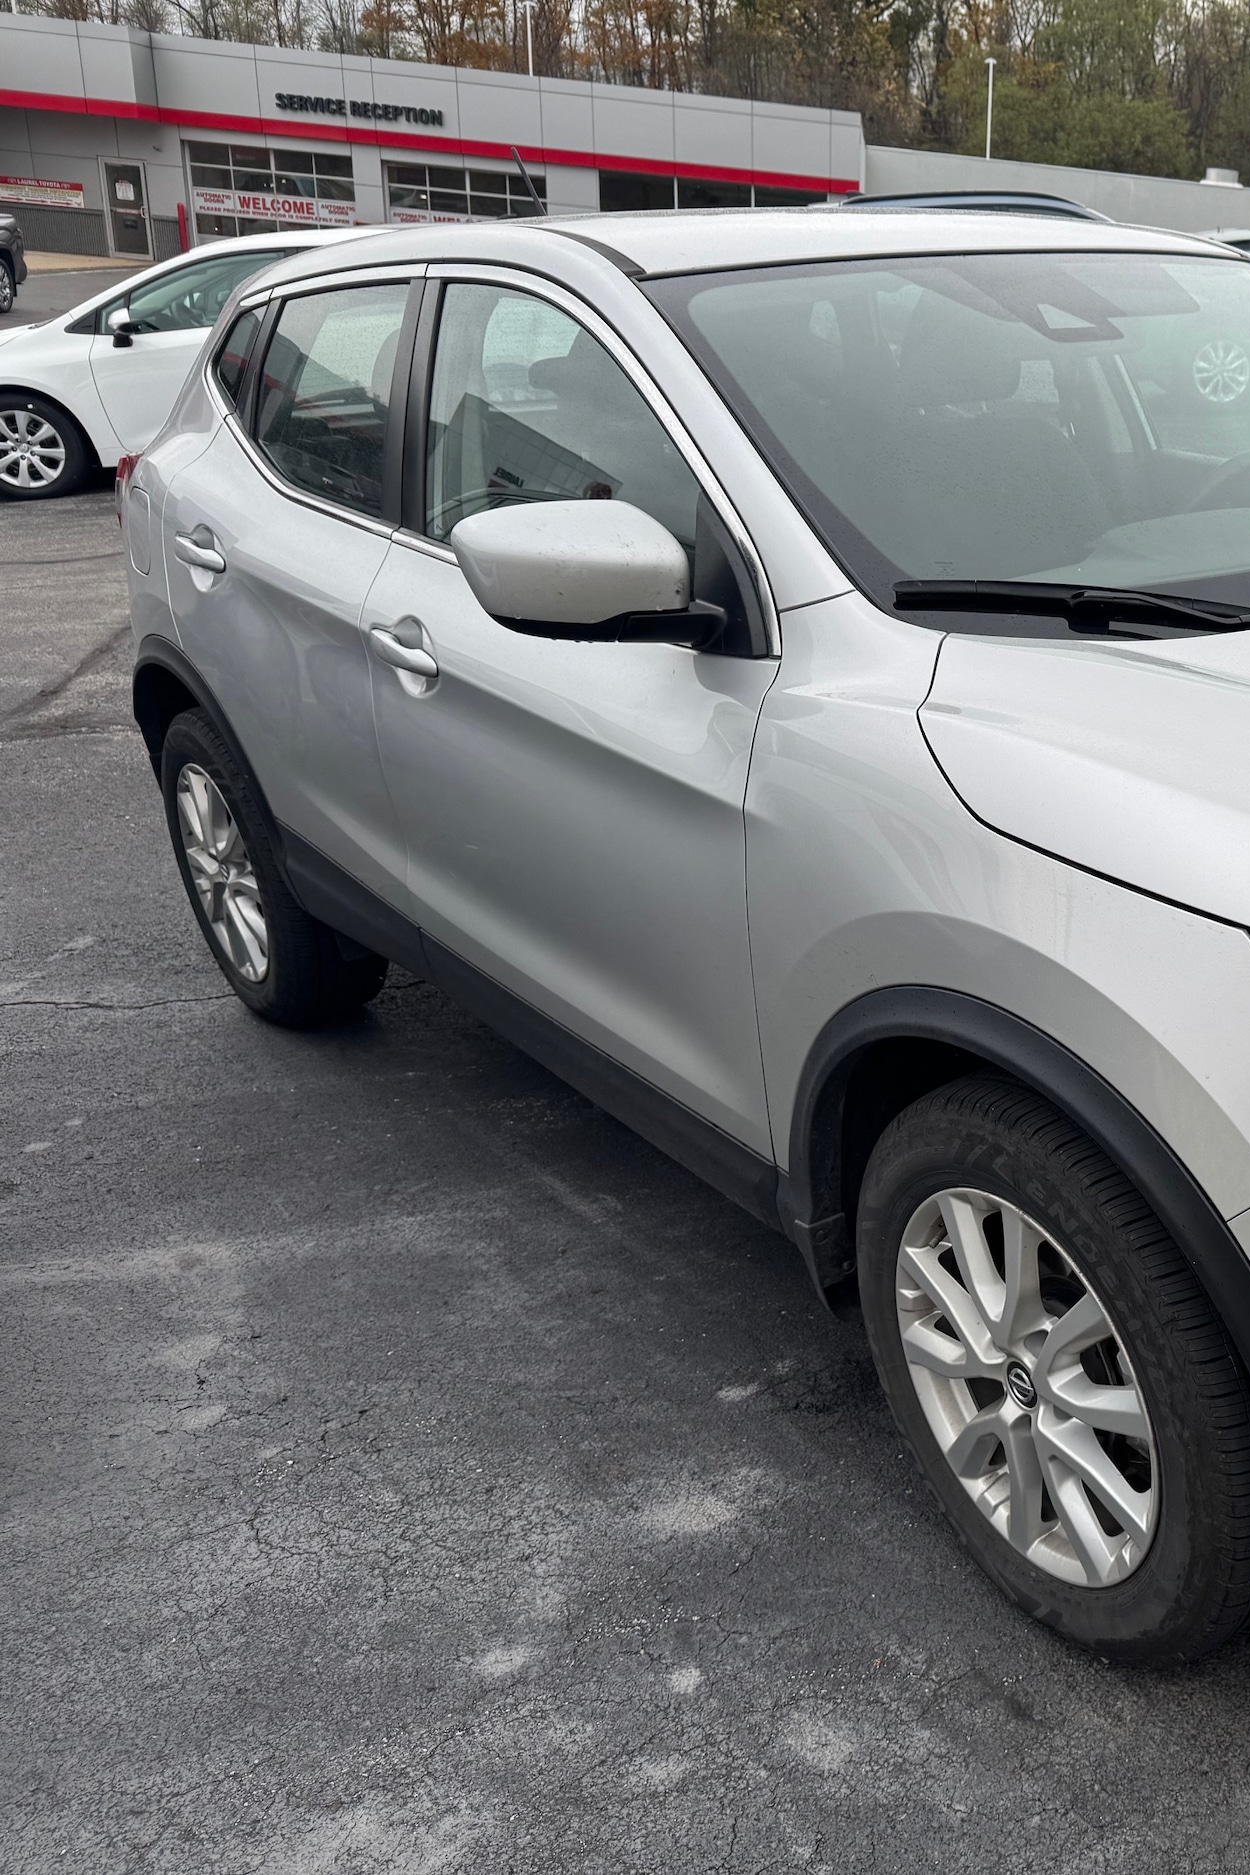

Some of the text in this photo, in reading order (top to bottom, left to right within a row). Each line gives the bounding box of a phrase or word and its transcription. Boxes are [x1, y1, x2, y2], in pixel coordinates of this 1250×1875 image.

[275, 92, 443, 126] SERVICE RECEPTION
[38, 180, 60, 188] TOYOTA
[195, 191, 232, 201] AUTOMATIC
[199, 205, 221, 213] PLEASE
[237, 195, 315, 215] WELCOME
[320, 203, 356, 212] AUTOMATIC
